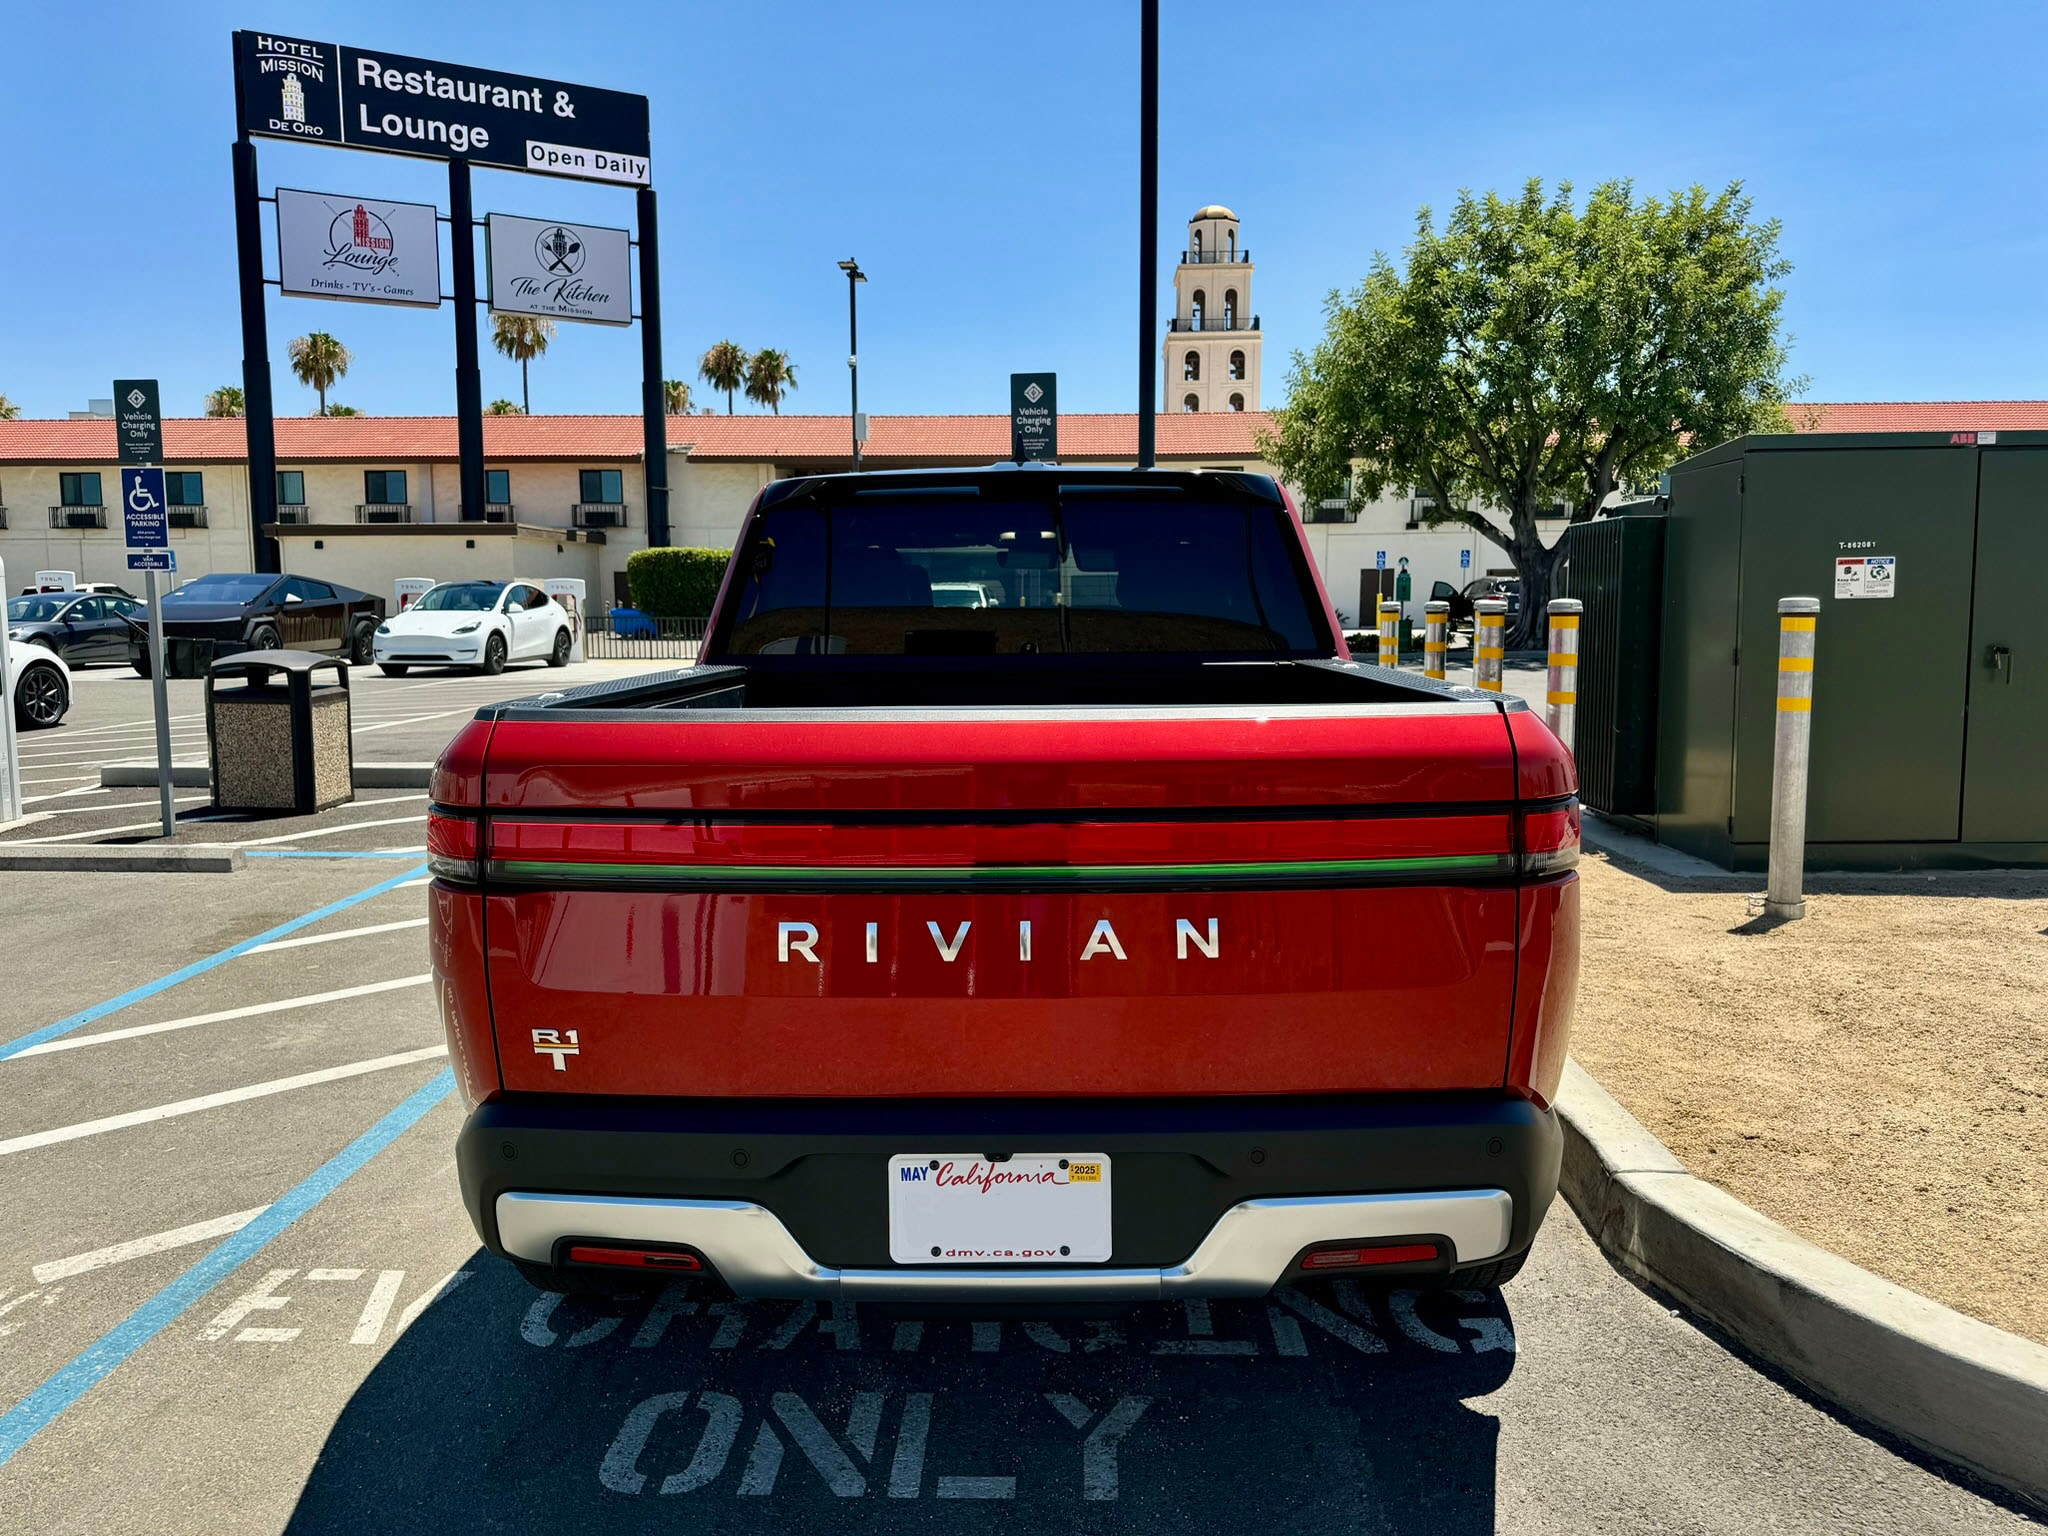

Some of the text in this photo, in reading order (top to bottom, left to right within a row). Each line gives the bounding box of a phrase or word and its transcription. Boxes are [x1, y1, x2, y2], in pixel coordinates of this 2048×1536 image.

[257, 35, 323, 59] HOTEL
[260, 58, 323, 83] MISSION
[357, 58, 577, 119] Restaurant &
[269, 119, 323, 136] DE ORO
[359, 104, 490, 152] Lounge
[530, 145, 647, 180] Open Daily
[355, 236, 390, 250] MISSION
[323, 242, 399, 276] Lounge
[311, 278, 344, 290] Drinks
[352, 282, 375, 292] TV's
[383, 285, 414, 296] Games
[511, 277, 611, 307] The Kitchen
[123, 412, 152, 421] Vehicle
[1019, 407, 1048, 416] Vehicle
[121, 422, 155, 431] Charging
[1016, 417, 1051, 426] Charging
[1024, 426, 1043, 434] Only
[130, 430, 148, 439] Only
[1951, 432, 1976, 445] ABB
[126, 513, 164, 521] ACCESSIBLE
[778, 917, 1219, 963] RIVIAN
[900, 1166, 929, 1182] MAY
[936, 1161, 1070, 1194] California
[1074, 1165, 1096, 1175] 2025
[945, 1248, 1057, 1258] dmv.ca.gov
[598, 1390, 1156, 1502] ONLY
